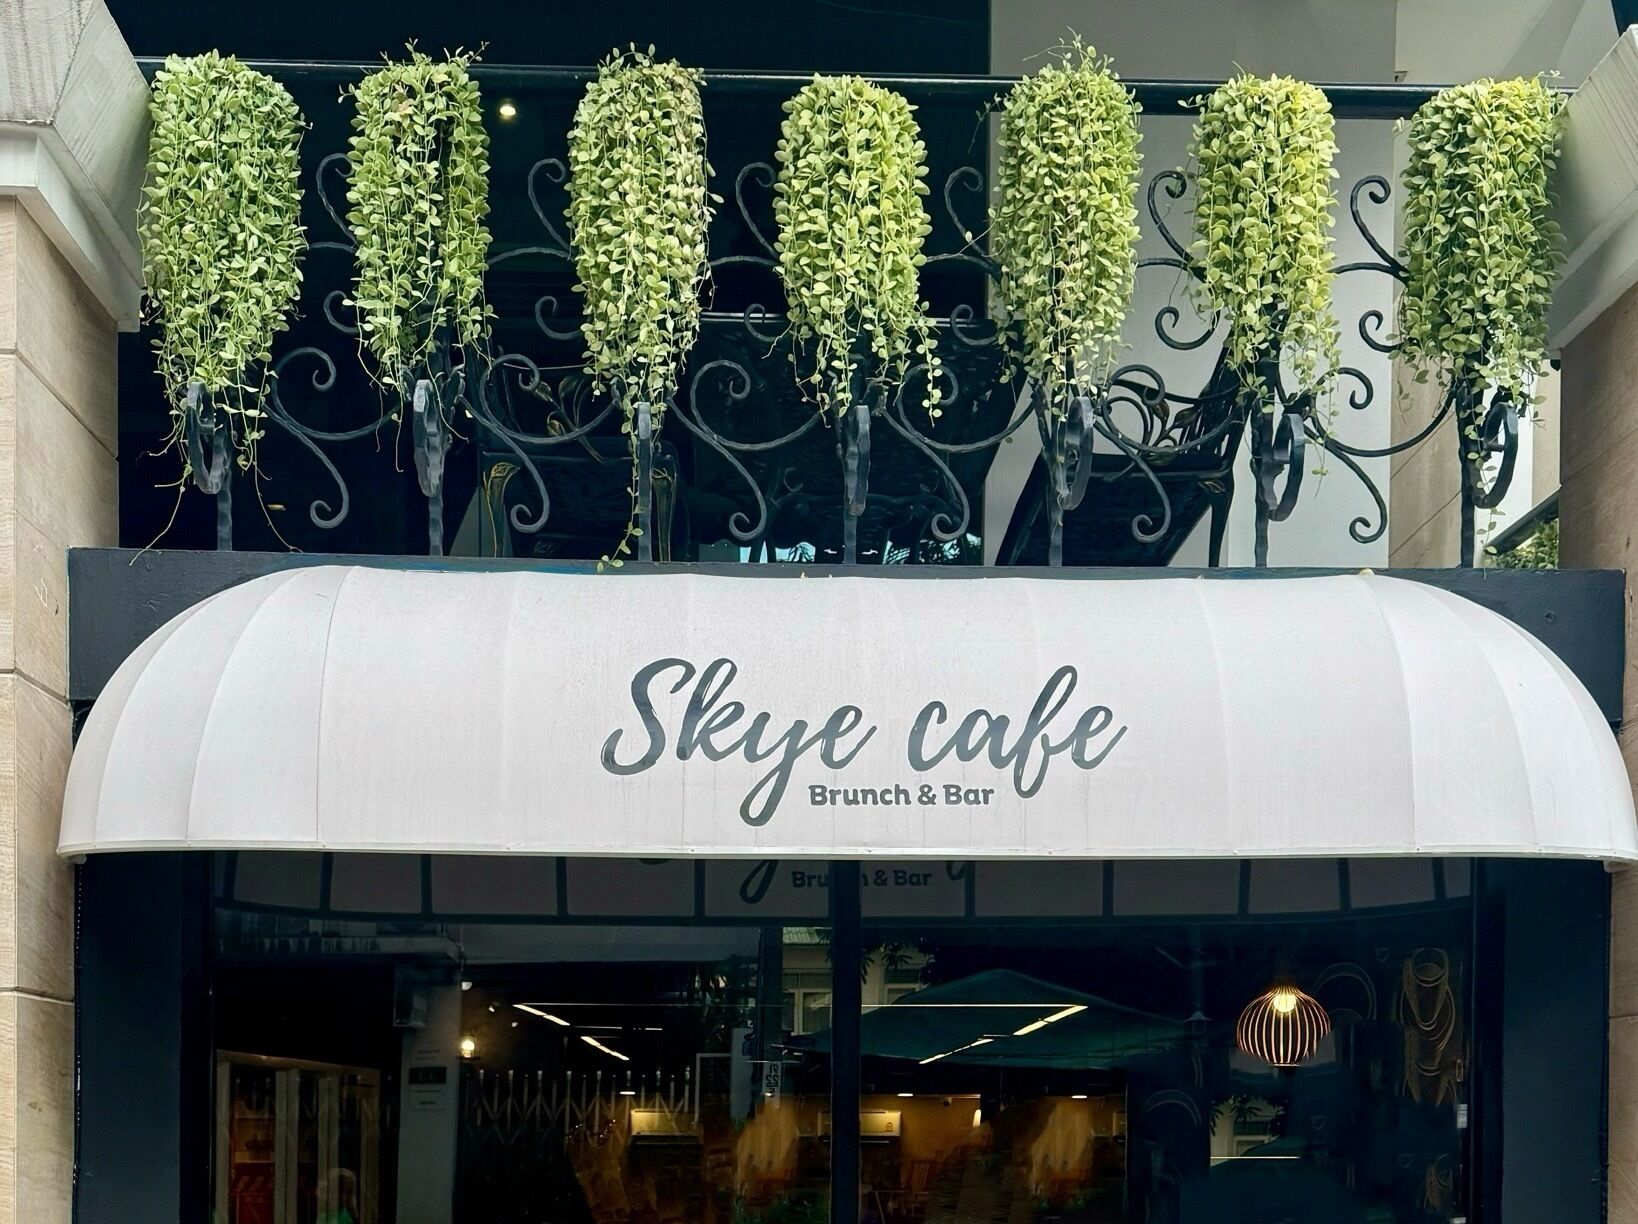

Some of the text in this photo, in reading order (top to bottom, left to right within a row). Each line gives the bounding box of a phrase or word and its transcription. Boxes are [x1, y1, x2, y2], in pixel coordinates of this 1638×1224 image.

[601, 657, 1127, 827] Skye cafe
[809, 783, 995, 806] Brunch & Bar
[874, 869, 888, 887] &
[893, 869, 932, 887] Bar
